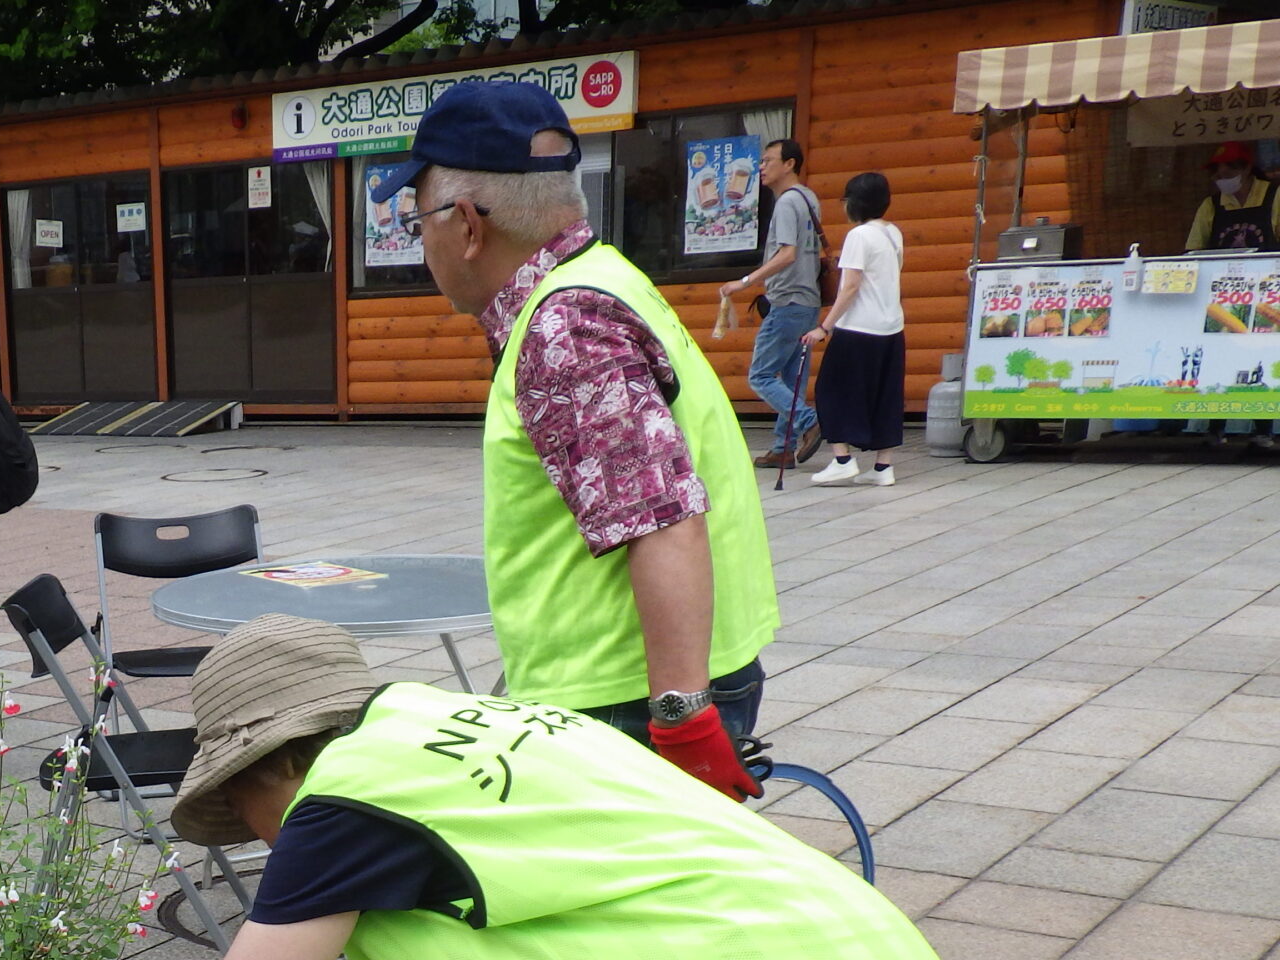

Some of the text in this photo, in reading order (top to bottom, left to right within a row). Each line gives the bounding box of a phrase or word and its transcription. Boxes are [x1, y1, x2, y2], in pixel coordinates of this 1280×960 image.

[589, 71, 614, 86] SAPP
[322, 62, 577, 125] 大通公園内所
[331, 123, 363, 139] Odori
[368, 122, 393, 135] Park
[40, 229, 59, 239] OPEN
[989, 297, 1021, 312] 350
[1033, 297, 1068, 311] 650
[1077, 295, 1113, 309] 600
[1217, 291, 1254, 305] 500
[1265, 291, 1280, 305] 5
[1175, 401, 1280, 414] 大通公園名物とうき
